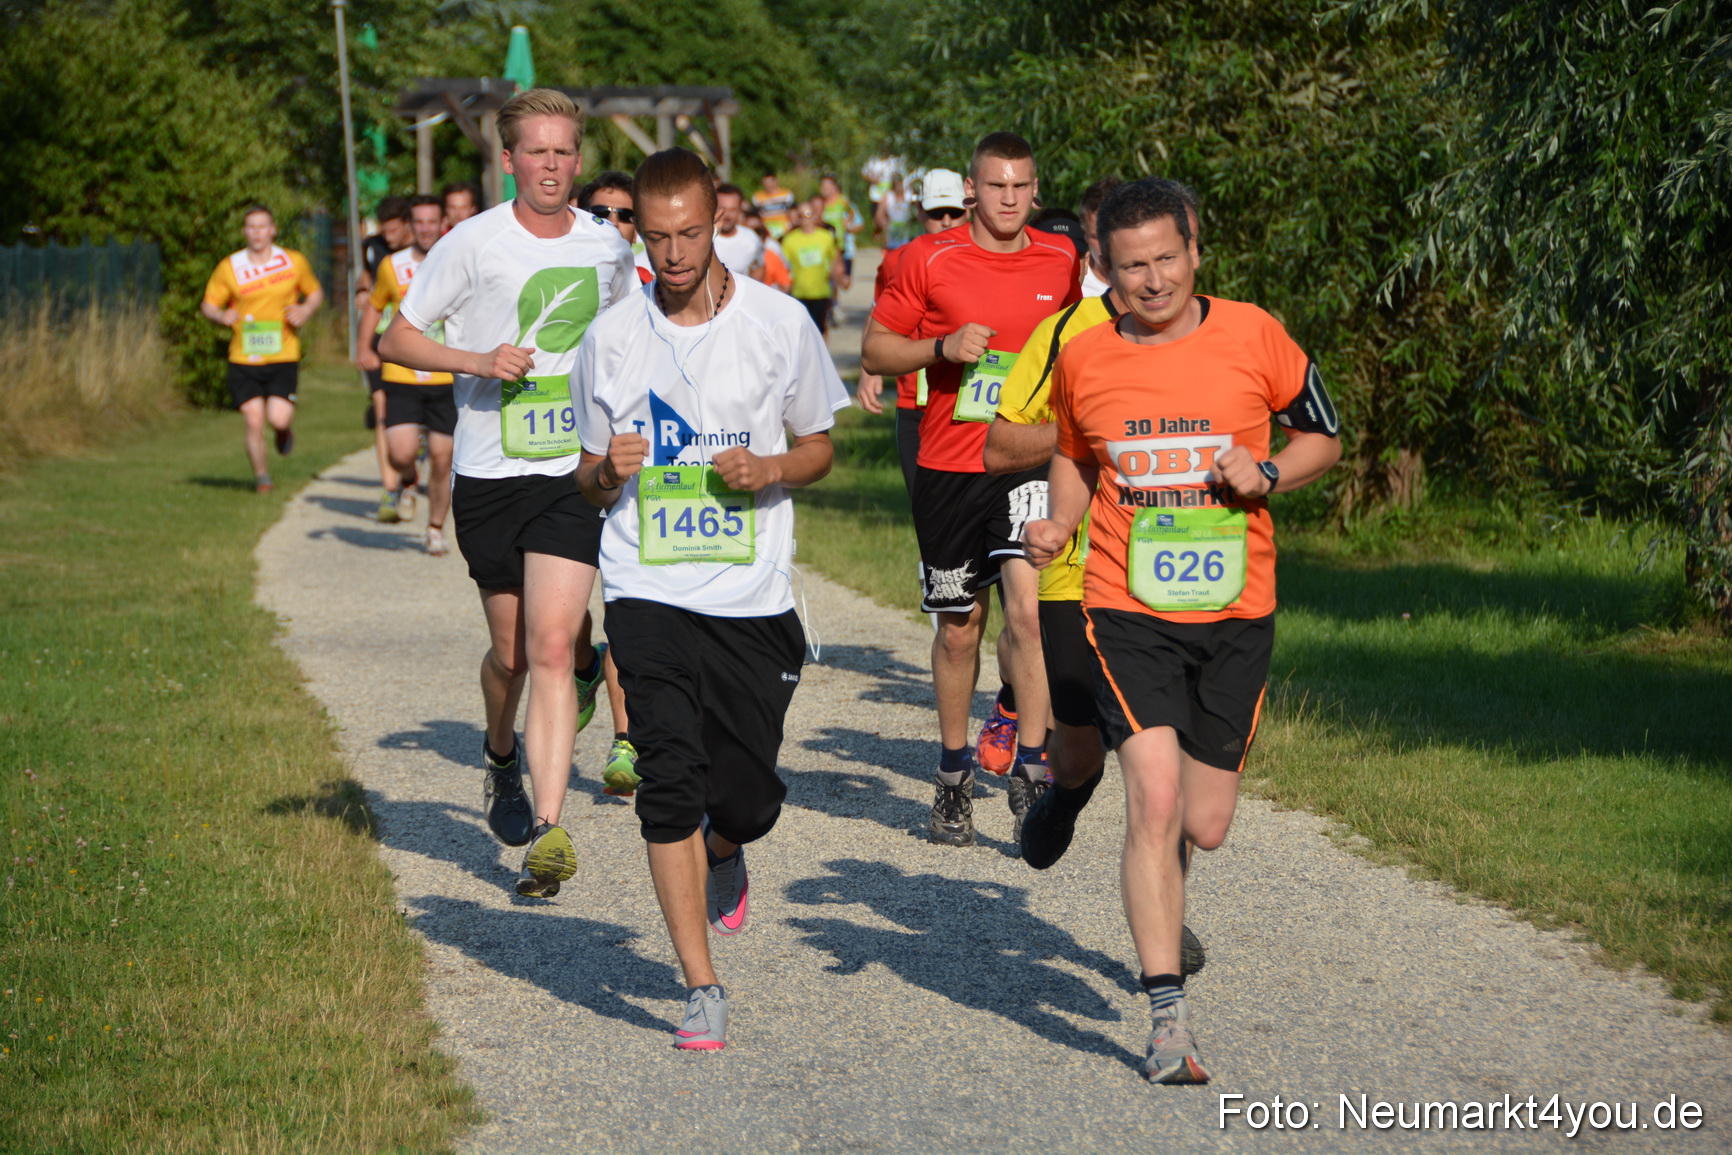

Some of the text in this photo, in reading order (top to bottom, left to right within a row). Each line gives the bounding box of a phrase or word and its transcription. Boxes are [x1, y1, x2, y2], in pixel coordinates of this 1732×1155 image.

[971, 379, 1002, 406] 10
[523, 407, 576, 435] 119
[660, 419, 751, 449] Running
[1124, 416, 1211, 437] 30 Jahre
[1117, 445, 1221, 477] OBI
[655, 482, 696, 490] firmenlauf
[1117, 484, 1236, 508] Neumarkt
[651, 506, 744, 538] 1465
[1148, 525, 1190, 533] firmenlauf
[1153, 550, 1225, 583] 626
